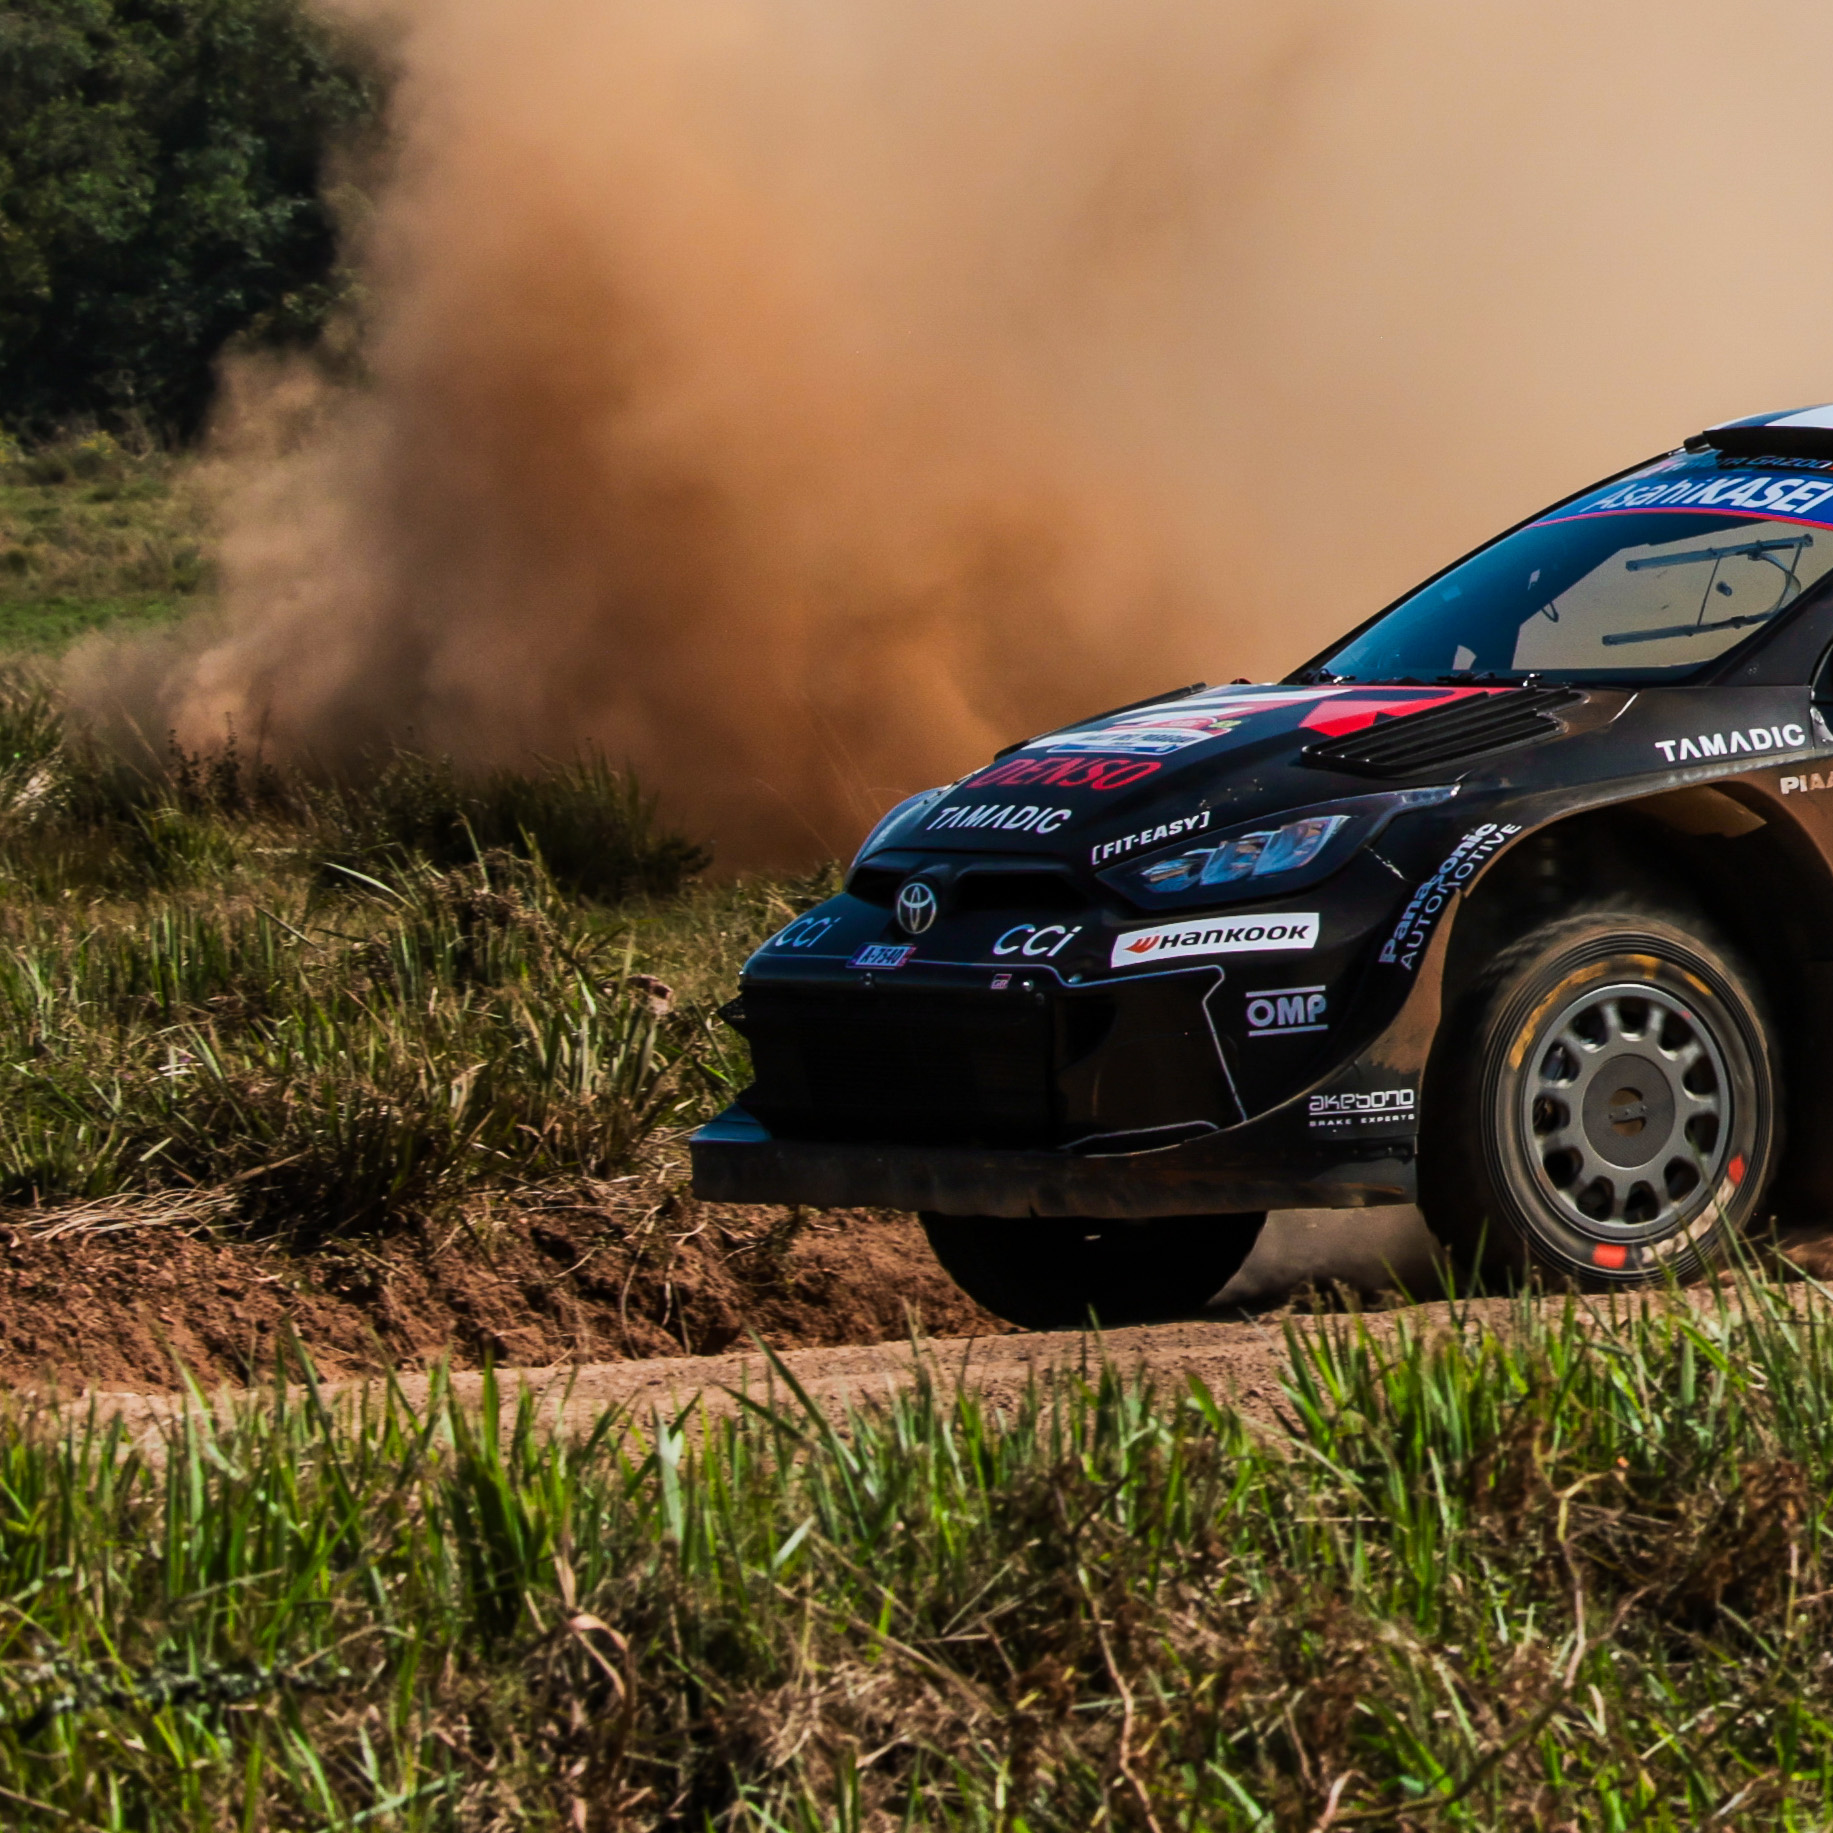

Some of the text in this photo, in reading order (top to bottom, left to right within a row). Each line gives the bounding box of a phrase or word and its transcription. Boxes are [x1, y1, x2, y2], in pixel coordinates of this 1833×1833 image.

[1655, 724, 1806, 762] TAMADIC
[964, 756, 1163, 791] DENSO
[926, 804, 1072, 834] TAMADIC
[1378, 823, 1498, 963] Panasonic
[1246, 993, 1327, 1028] OMP
[1308, 1088, 1415, 1112] akebono
[1308, 1114, 1415, 1128] BRAKE EXPERTS
